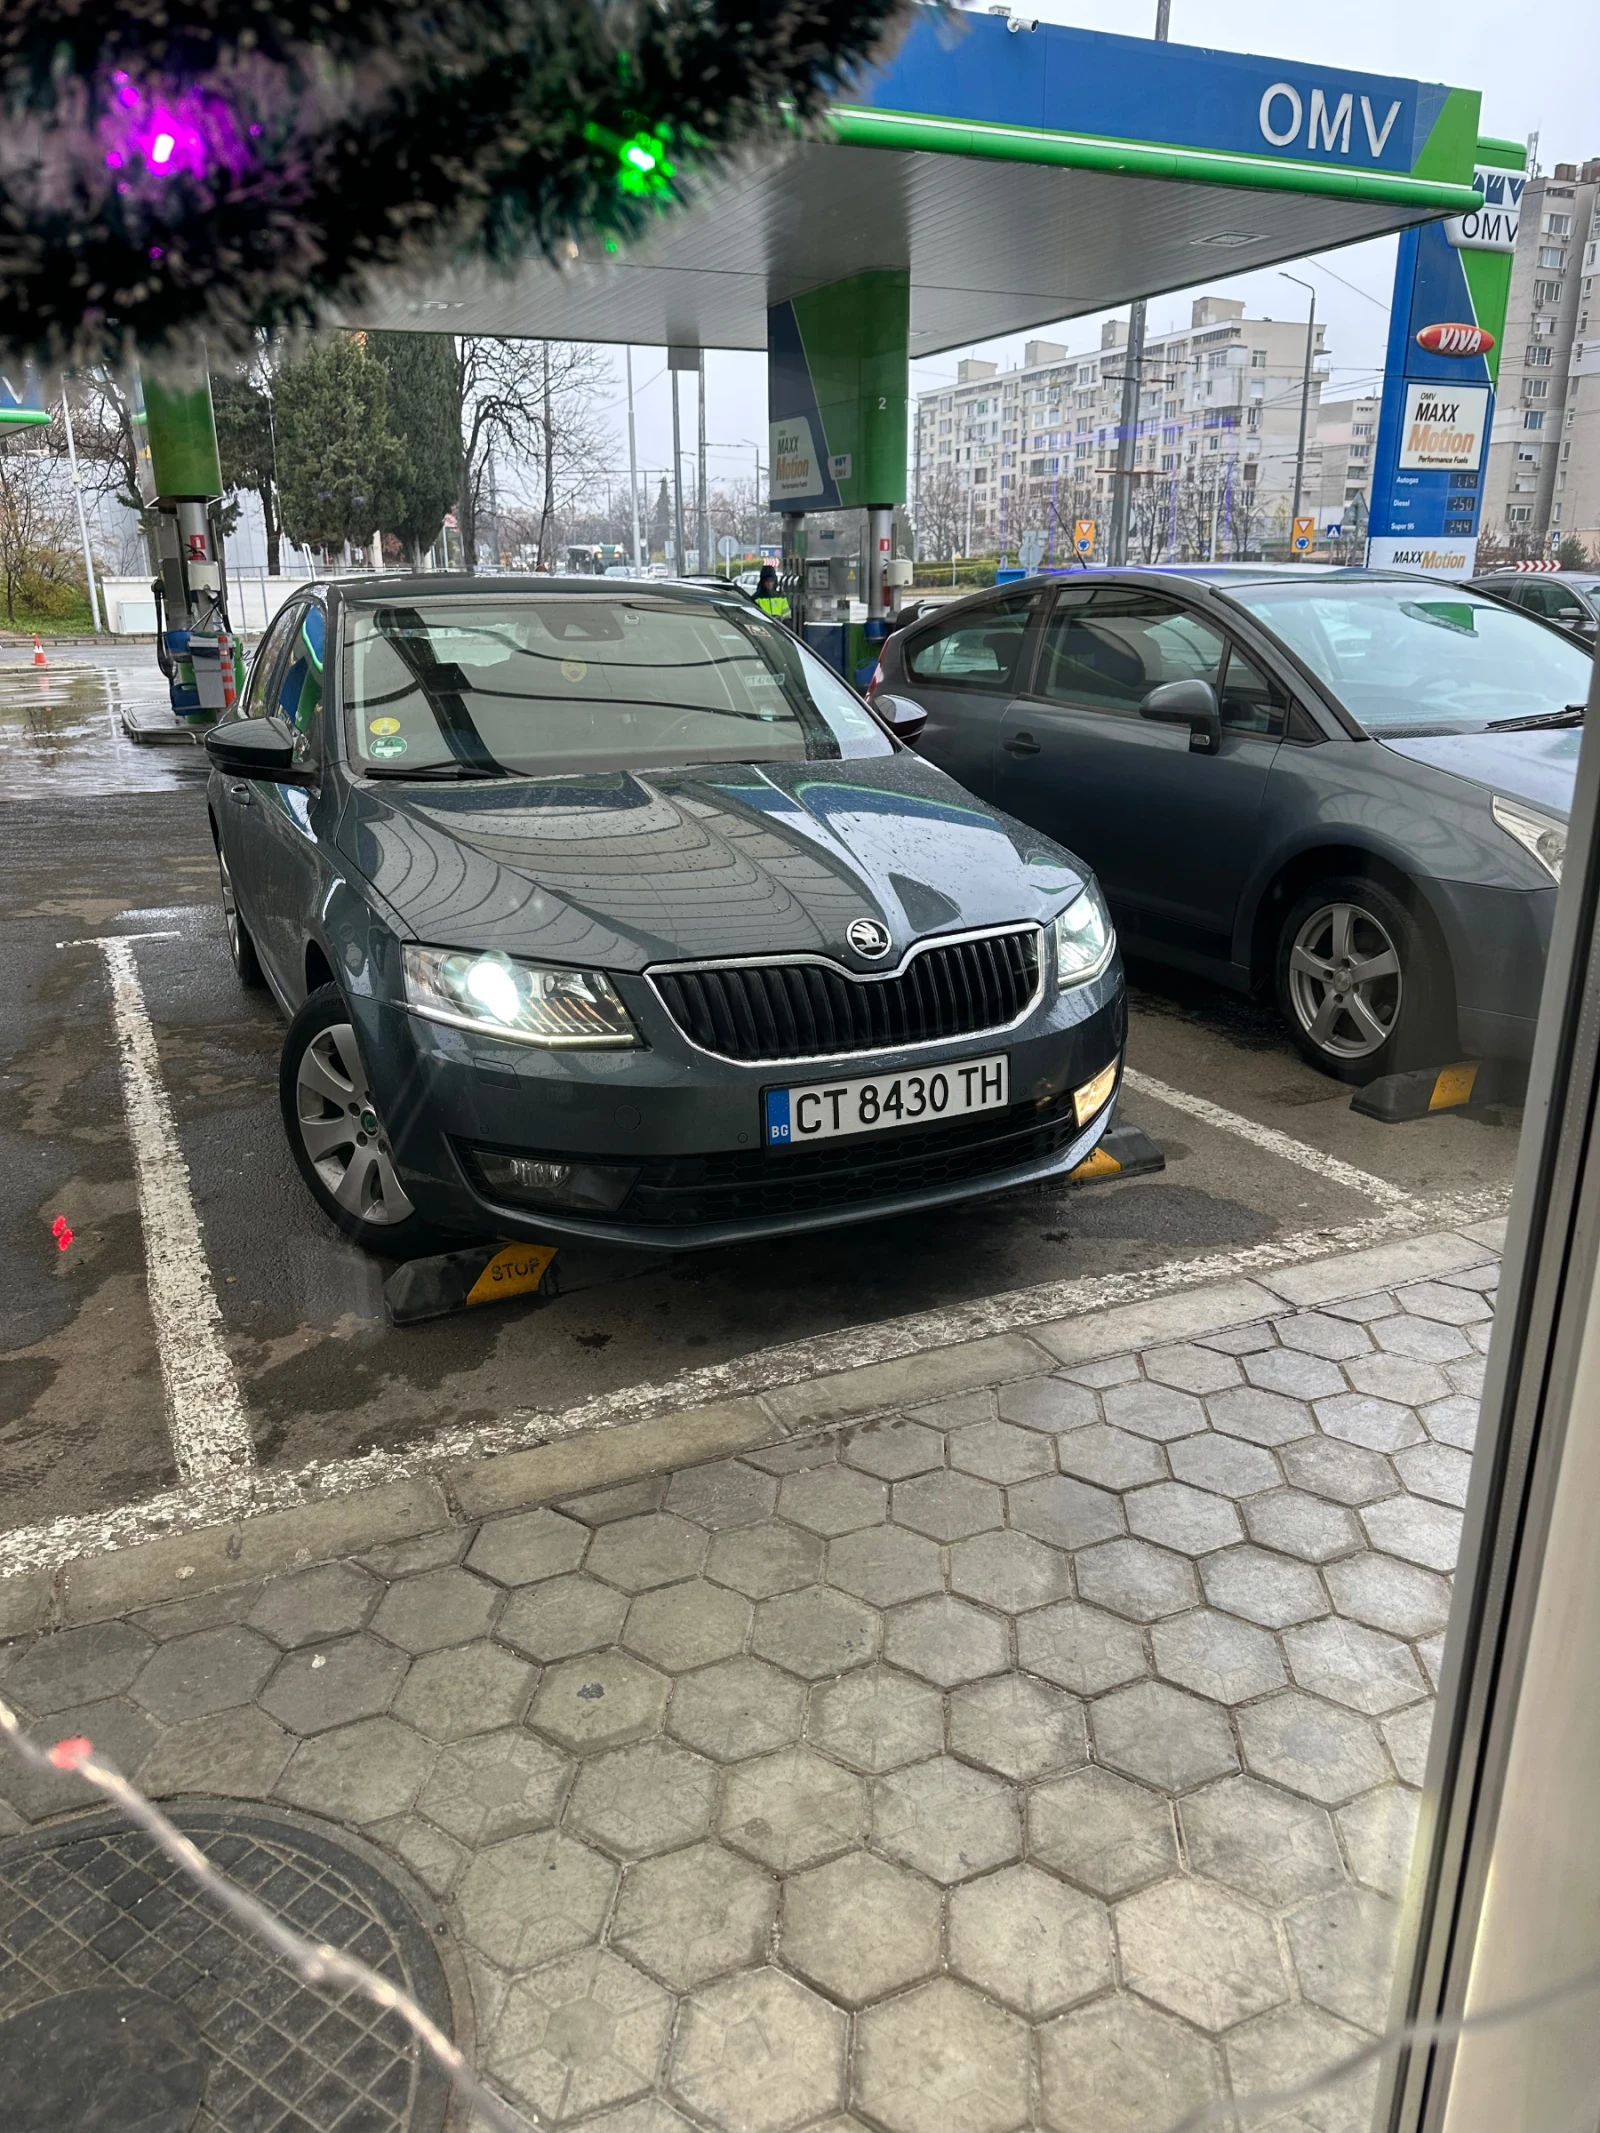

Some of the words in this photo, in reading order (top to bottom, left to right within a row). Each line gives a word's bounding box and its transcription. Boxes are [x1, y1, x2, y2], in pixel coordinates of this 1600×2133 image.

[1259, 82, 1402, 158] OMV
[1462, 212, 1519, 242] OMV
[1438, 326, 1482, 352] VIVA
[878, 396, 887, 410] 2
[1420, 392, 1437, 401] OMV
[1415, 402, 1460, 423] MAXX
[777, 436, 799, 454] MAXX
[1407, 424, 1475, 453] Motion
[776, 455, 809, 481] Motion
[1418, 455, 1452, 464] Performance
[1453, 456, 1469, 464] Fuels
[1396, 476, 1419, 485] Autogas
[1393, 499, 1410, 507] Diesel
[1391, 522, 1406, 531] Super
[1407, 522, 1415, 530] 95
[1392, 551, 1423, 564] MAXX
[1421, 550, 1466, 569] Motion
[796, 1088, 848, 1133] CT
[857, 1073, 949, 1124] 8430
[957, 1062, 1002, 1107] TH
[770, 1123, 789, 1138] BG
[491, 1257, 540, 1281] STOP
